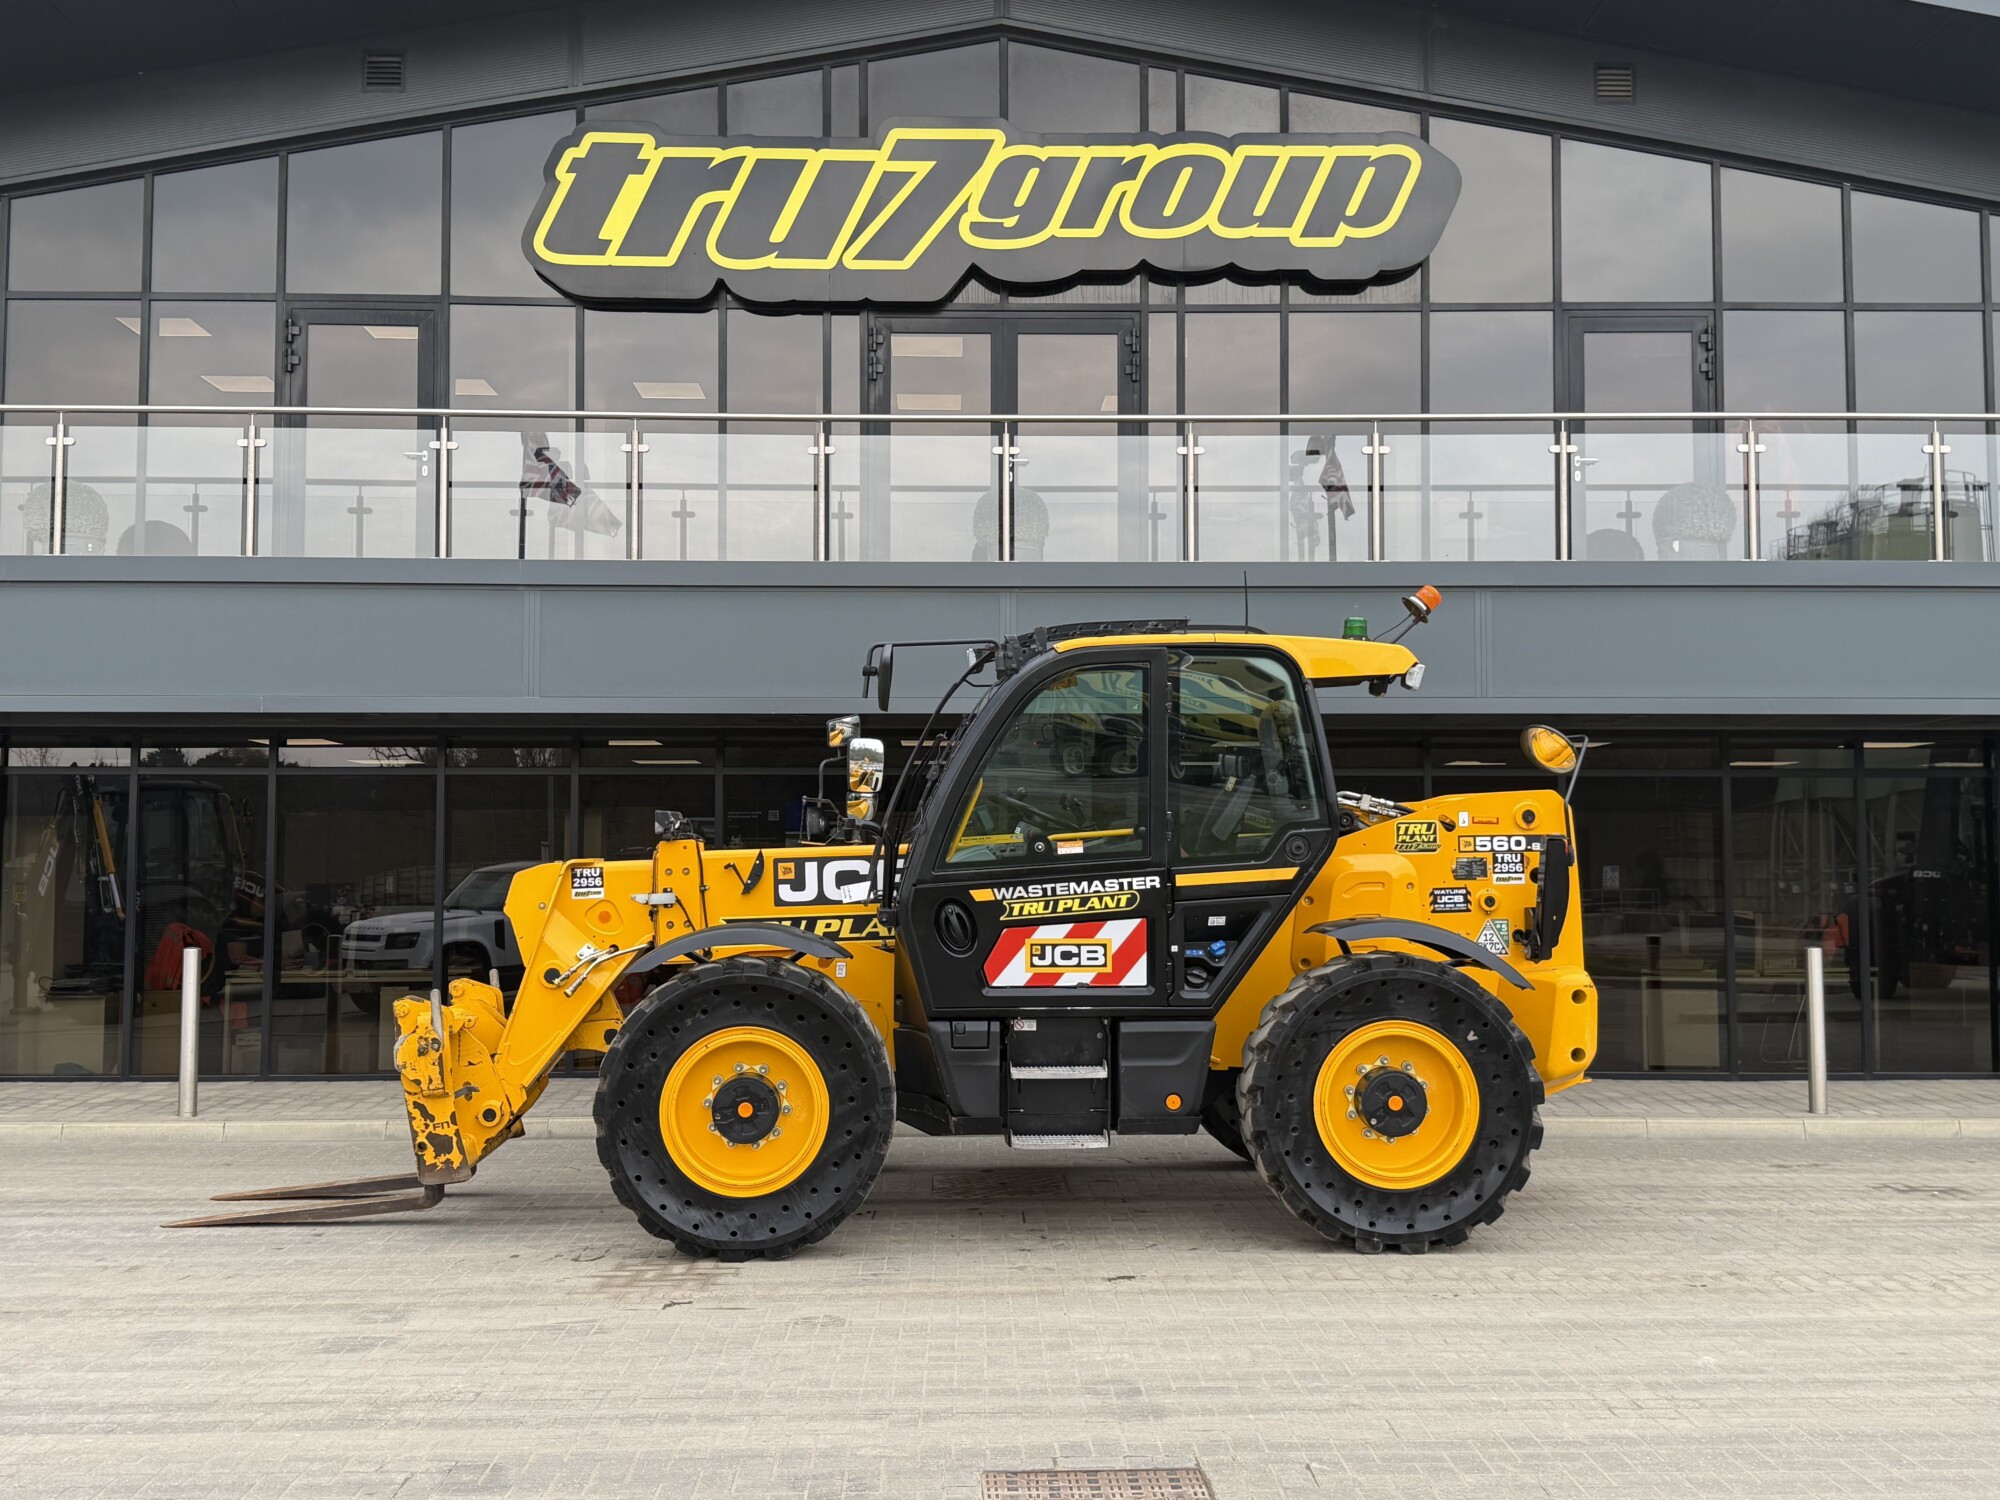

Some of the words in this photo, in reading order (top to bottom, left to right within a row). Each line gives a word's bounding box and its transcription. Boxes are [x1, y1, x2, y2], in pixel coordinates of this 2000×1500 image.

[1397, 824, 1436, 835] TRU
[1495, 853, 1521, 862] TRU
[1494, 863, 1523, 872] 2956
[574, 868, 600, 877] TRU
[572, 877, 602, 887] 2956
[993, 875, 1161, 901] WASTEMASTER
[1436, 895, 1464, 903] JCB
[1010, 899, 1055, 917] TRU
[1057, 894, 1133, 913] PLANT
[1483, 933, 1494, 941] 12
[1031, 945, 1106, 967] JCB
